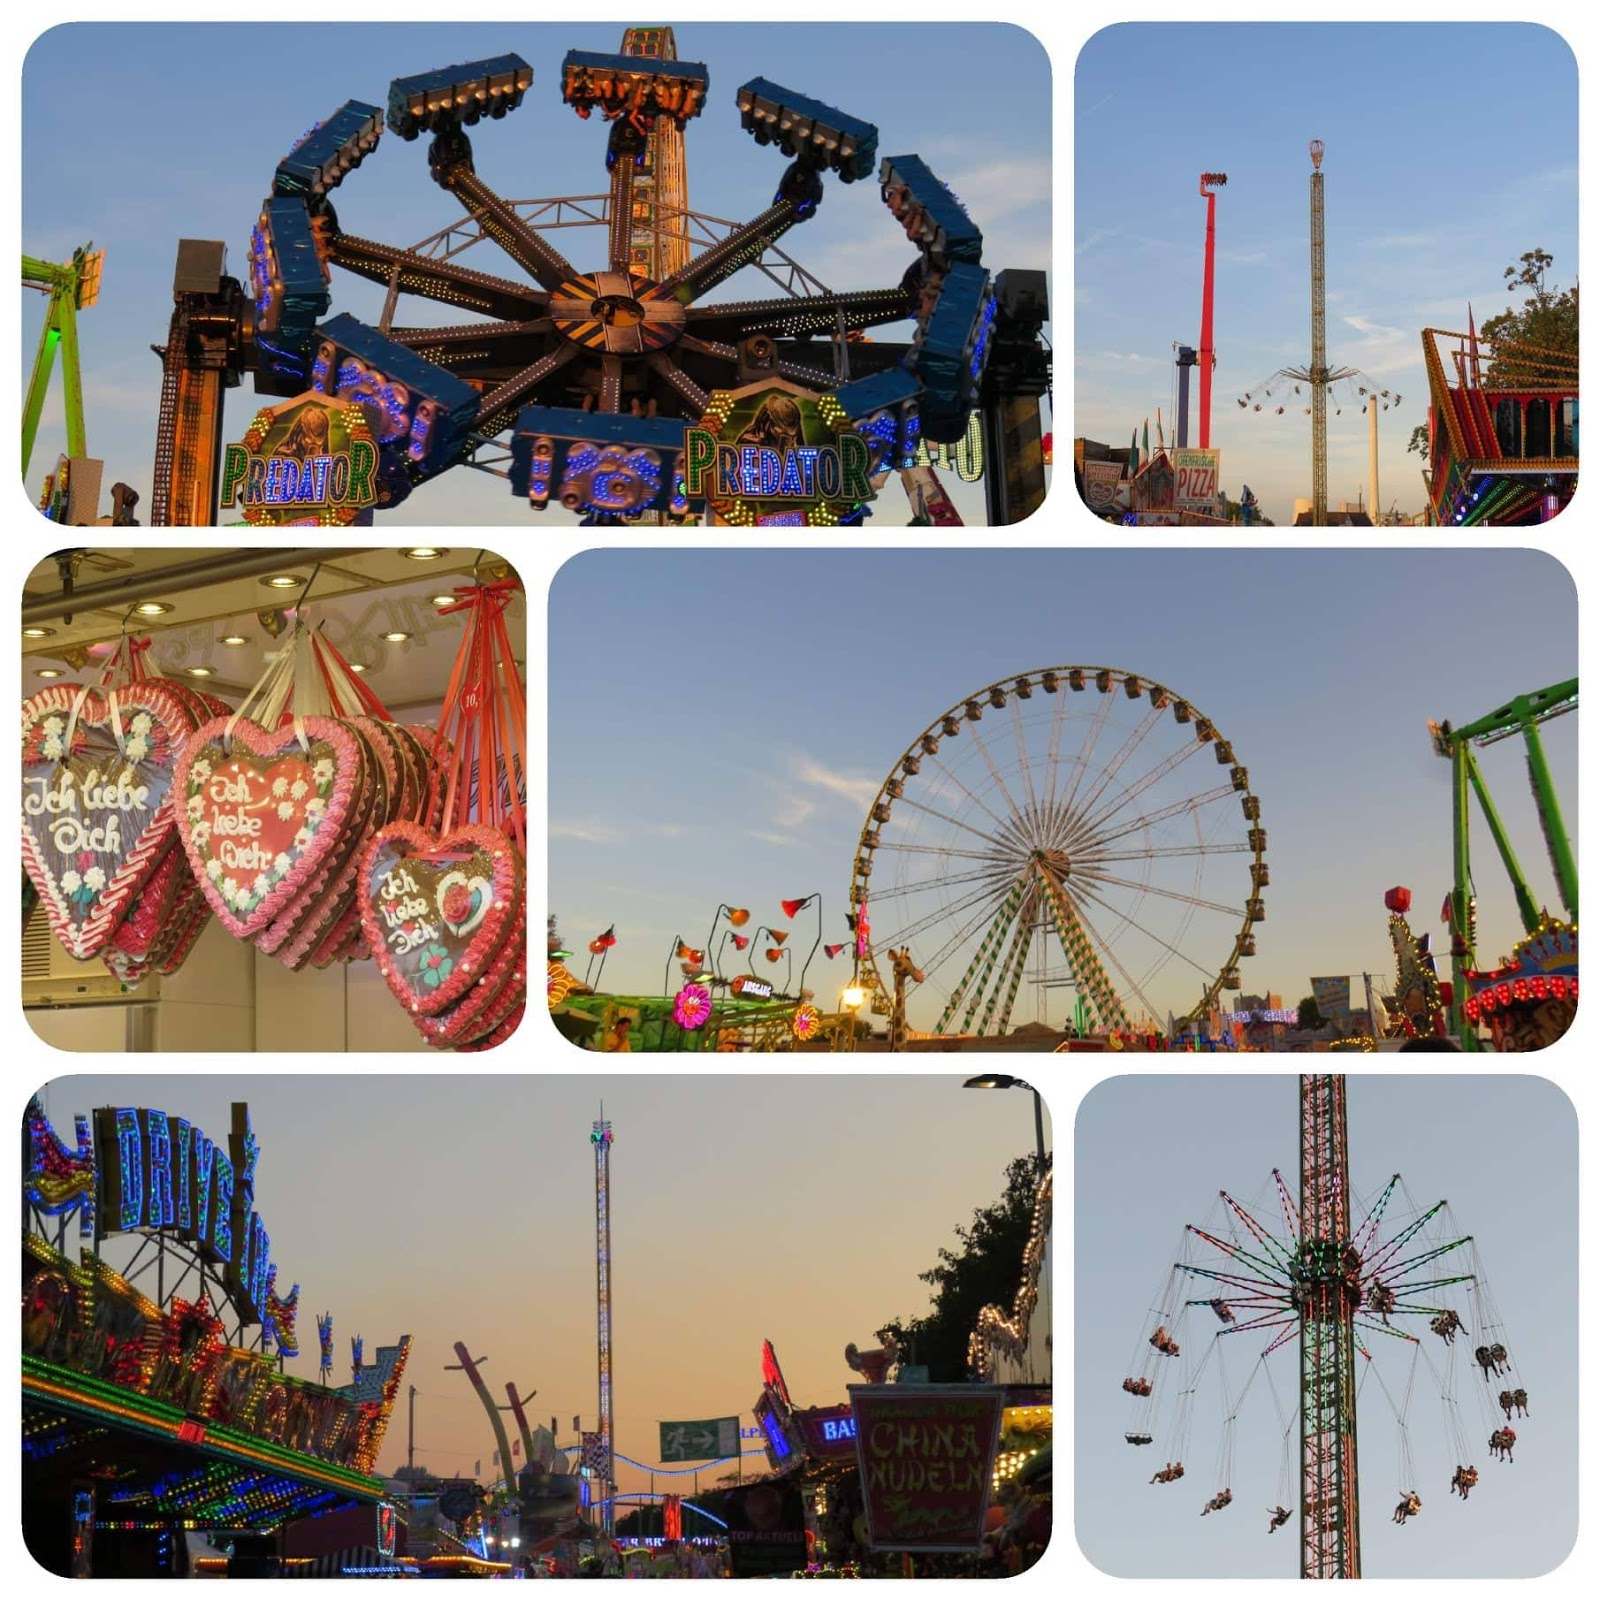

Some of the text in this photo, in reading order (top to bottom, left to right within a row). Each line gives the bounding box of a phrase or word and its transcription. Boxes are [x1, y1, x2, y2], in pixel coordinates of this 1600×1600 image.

[220, 440, 379, 509] PREDATOR
[684, 427, 875, 500] PREDATOR
[1177, 467, 1217, 498] PIZZA
[23, 769, 149, 816] Ich liebe
[210, 773, 253, 803] Ich
[48, 815, 121, 854] Dich
[378, 868, 420, 900] Ich
[380, 895, 430, 928] liebe
[388, 917, 439, 955] Dich
[116, 1107, 234, 1263] DRIVE
[869, 1421, 982, 1459] CHINA
[869, 1459, 985, 1494] NUDELN
